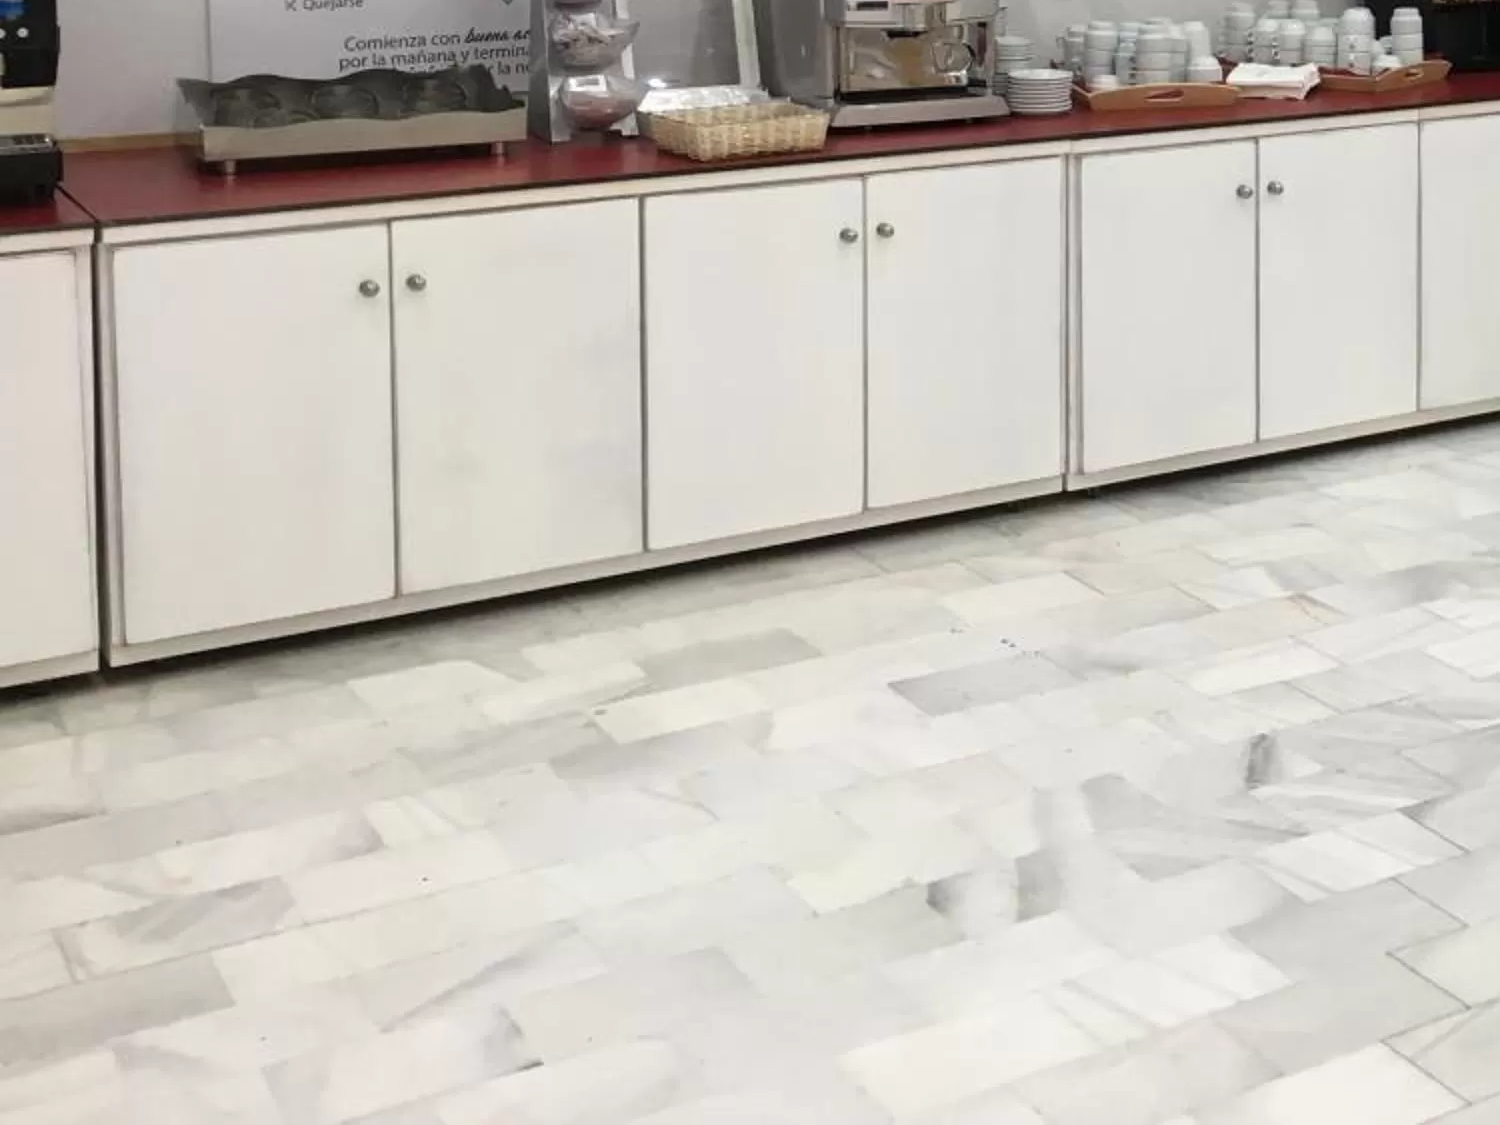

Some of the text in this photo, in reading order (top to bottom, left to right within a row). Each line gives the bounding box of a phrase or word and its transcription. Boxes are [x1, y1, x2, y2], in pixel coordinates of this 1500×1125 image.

[343, 35, 427, 52] Comienza
[431, 32, 461, 47] con
[464, 26, 508, 44] buena
[338, 55, 368, 72] por
[372, 53, 387, 67] la
[391, 47, 457, 65] mañana
[461, 49, 470, 63] y
